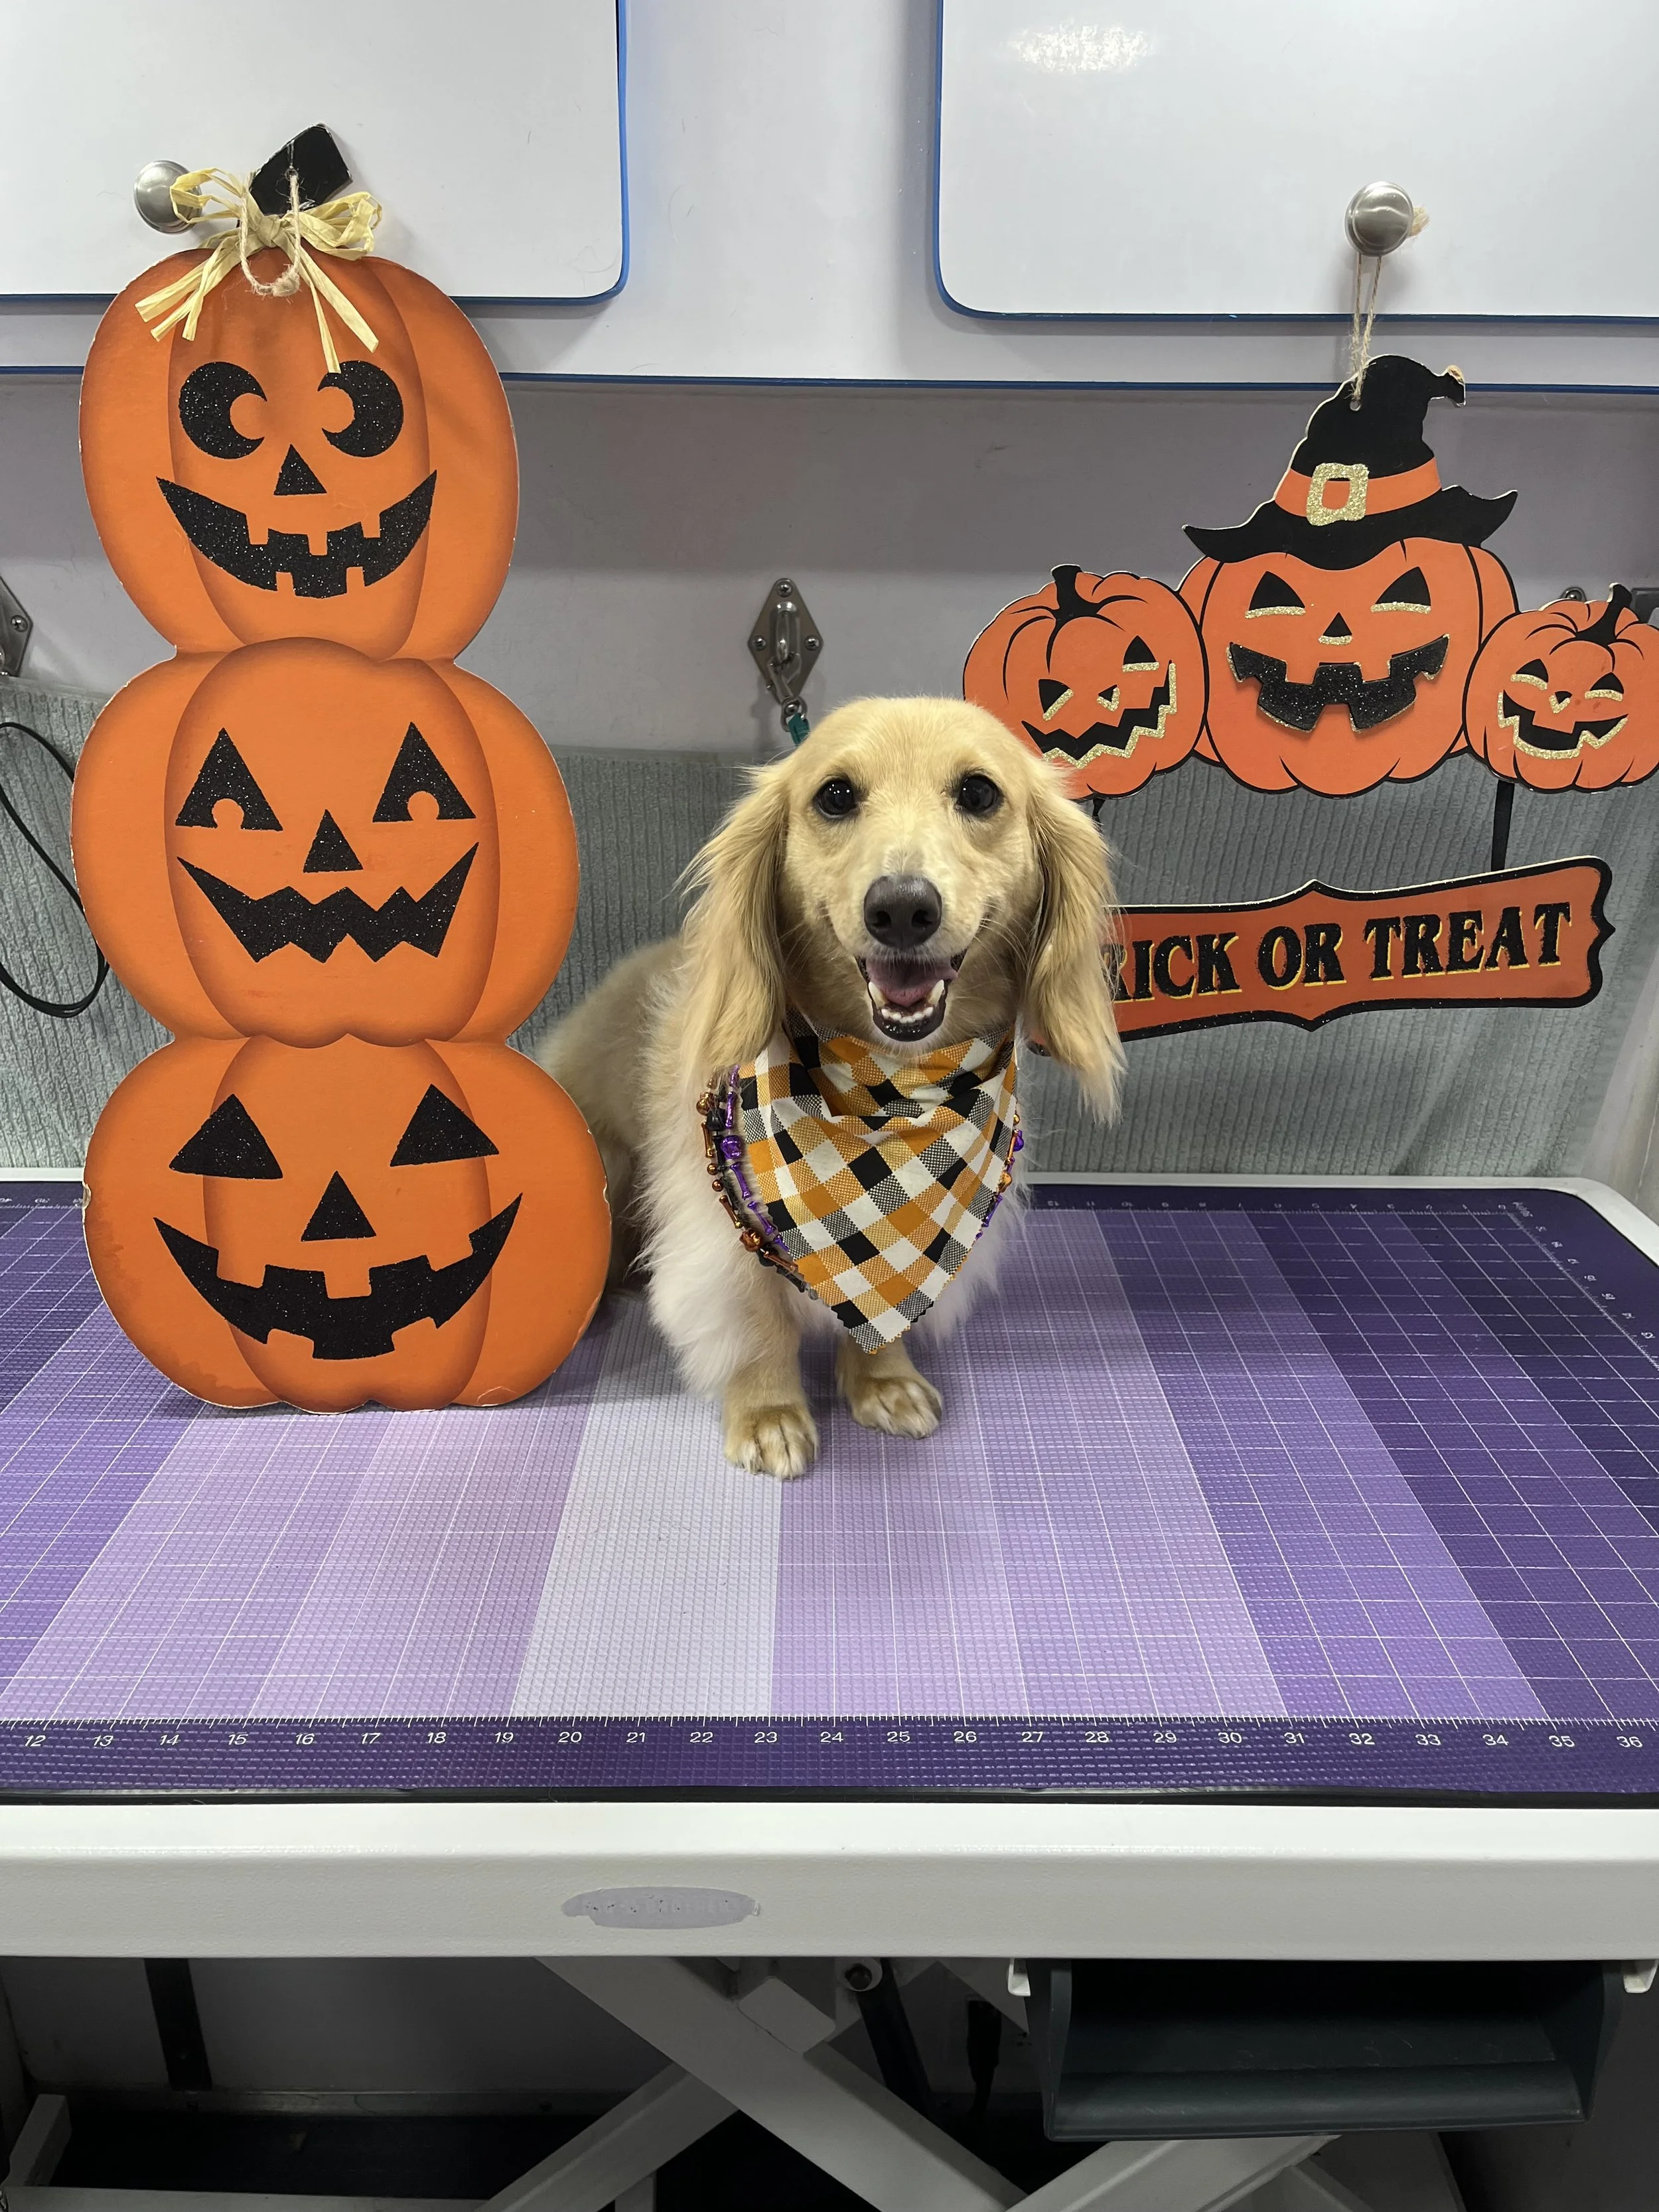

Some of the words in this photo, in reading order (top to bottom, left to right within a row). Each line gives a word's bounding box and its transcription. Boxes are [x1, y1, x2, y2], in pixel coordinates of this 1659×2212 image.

[1100, 931, 1242, 1003] RICK
[1258, 922, 1346, 990] OR
[1364, 901, 1572, 980] TREAT
[25, 1735, 46, 1747] 12
[93, 1735, 114, 1747] 13
[160, 1734, 180, 1745] 14
[228, 1733, 249, 1745] 15
[295, 1733, 315, 1745] 16
[361, 1732, 381, 1745] 17
[427, 1732, 447, 1744] 18
[494, 1732, 514, 1744] 19
[557, 1732, 582, 1743] 20
[626, 1732, 646, 1743] 21
[689, 1732, 713, 1743] 22
[754, 1732, 778, 1743] 23
[820, 1731, 843, 1743] 24
[887, 1731, 910, 1743] 25
[954, 1731, 977, 1743] 26
[1021, 1731, 1044, 1743] 27
[1084, 1731, 1110, 1743] 28
[1153, 1731, 1177, 1743] 29
[1218, 1732, 1242, 1743] 30
[1283, 1732, 1305, 1744] 31
[1348, 1733, 1375, 1745] 32
[1415, 1733, 1441, 1746] 33
[1482, 1734, 1509, 1746] 34
[1548, 1735, 1575, 1747] 35
[1616, 1735, 1643, 1747] 36
